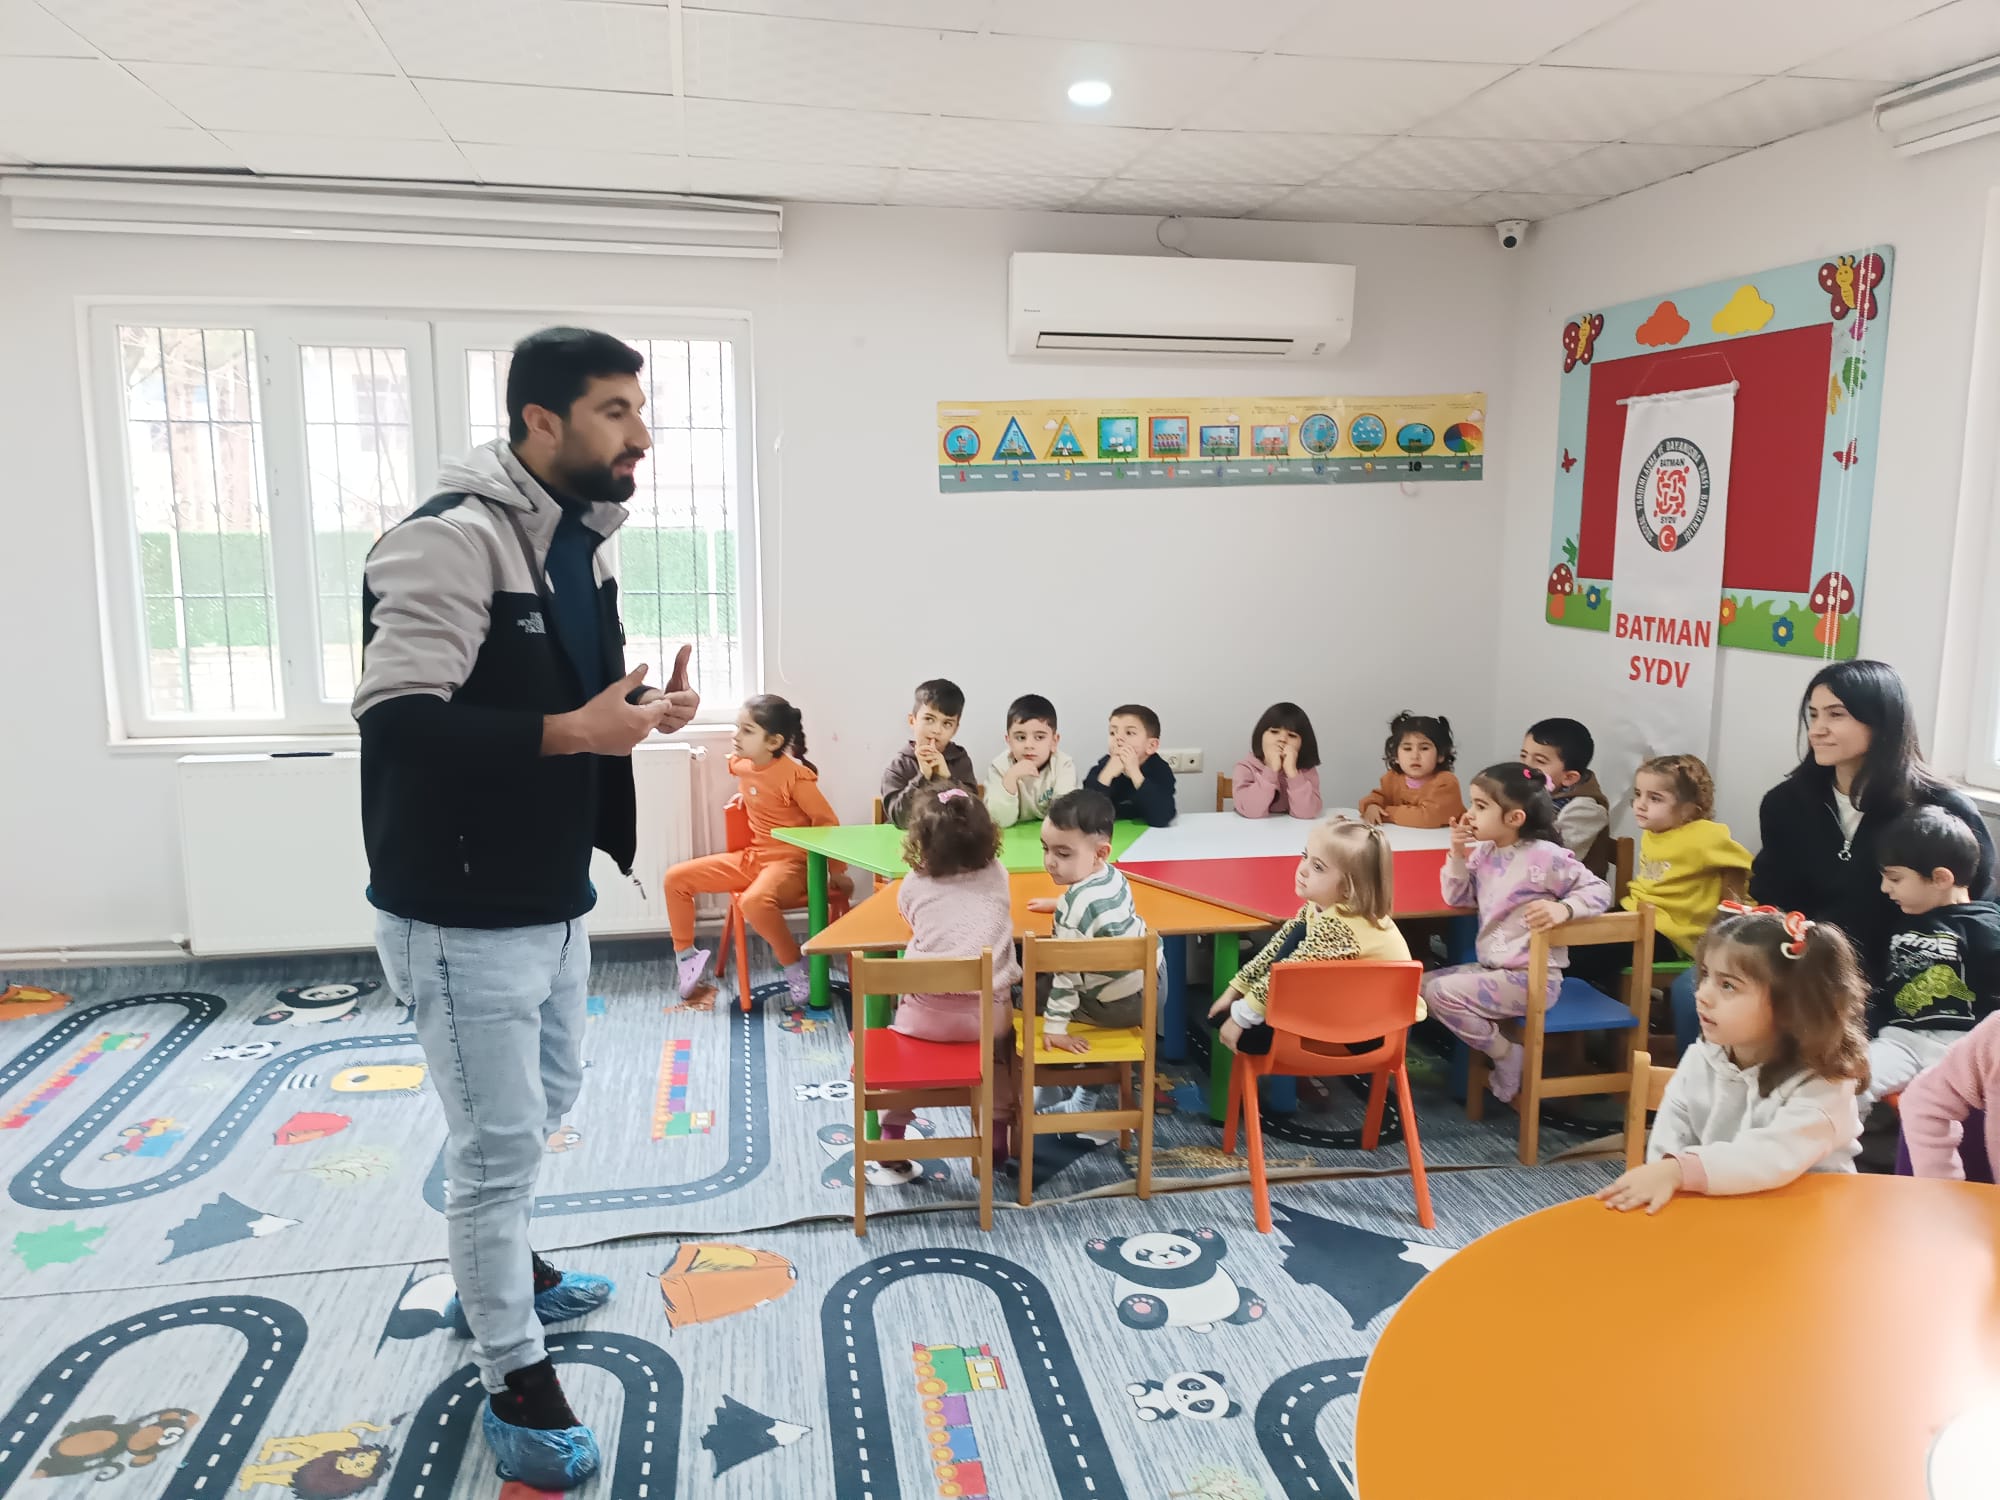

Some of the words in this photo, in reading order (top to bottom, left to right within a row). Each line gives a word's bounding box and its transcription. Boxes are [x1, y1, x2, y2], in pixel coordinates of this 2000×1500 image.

[1408, 461, 1422, 472] 10
[1660, 458, 1685, 467] BATMAN
[1615, 613, 1711, 648] BATMAN
[1629, 655, 1691, 688] SYDV
